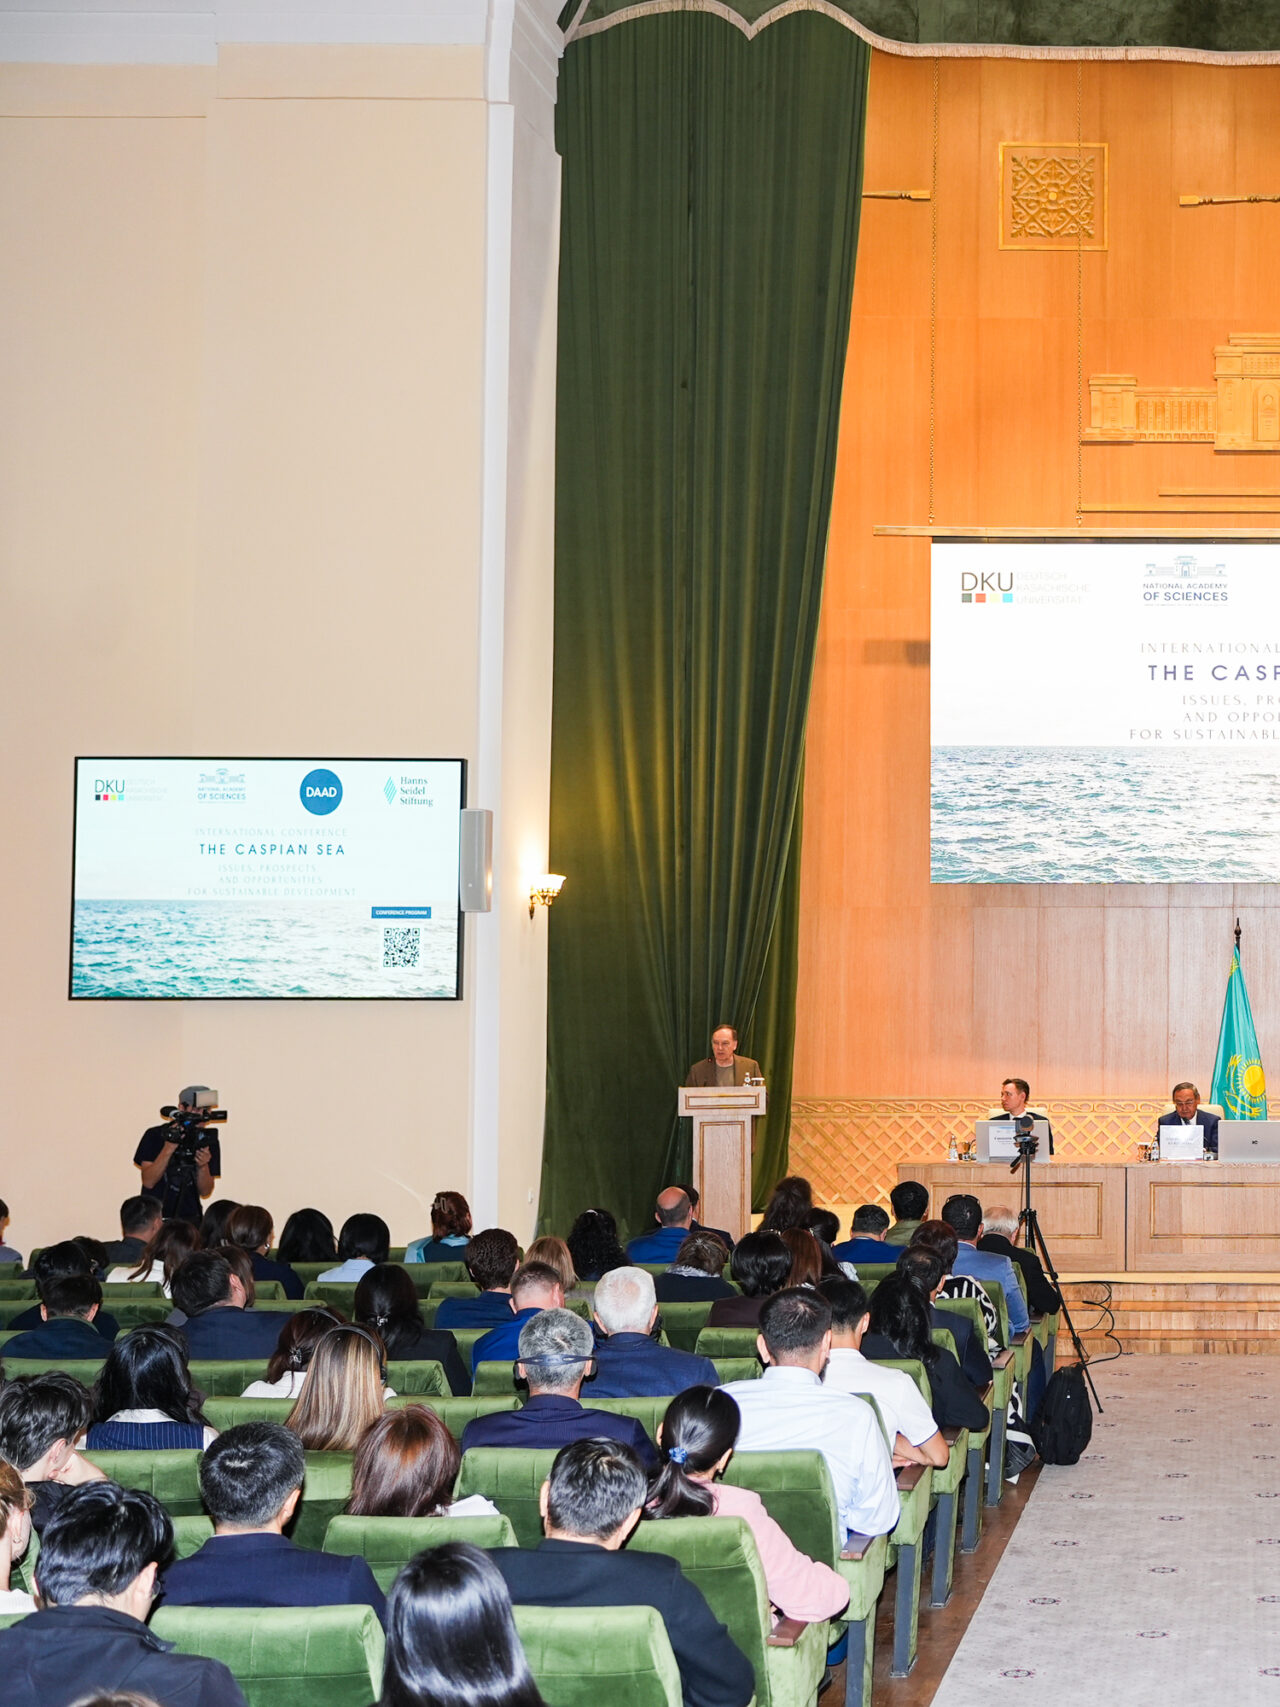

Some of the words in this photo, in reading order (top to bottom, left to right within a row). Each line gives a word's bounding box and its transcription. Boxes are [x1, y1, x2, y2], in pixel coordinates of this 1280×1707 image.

[962, 572, 1013, 592] DKU
[1143, 592, 1159, 602] OF
[1164, 591, 1229, 602] SCIENCES
[1148, 665, 1194, 681] THE
[1182, 695, 1247, 706] ISSUES,
[1183, 712, 1218, 722] AND
[1129, 729, 1163, 740] FOR
[95, 779, 125, 793] DKU
[400, 776, 428, 786] Hanns
[306, 787, 337, 798] DAAD
[400, 786, 426, 796] Seidel
[400, 796, 434, 807] Stiftung
[200, 843, 226, 856] THE
[234, 843, 308, 856] CASPIAN
[316, 843, 345, 856] SEA
